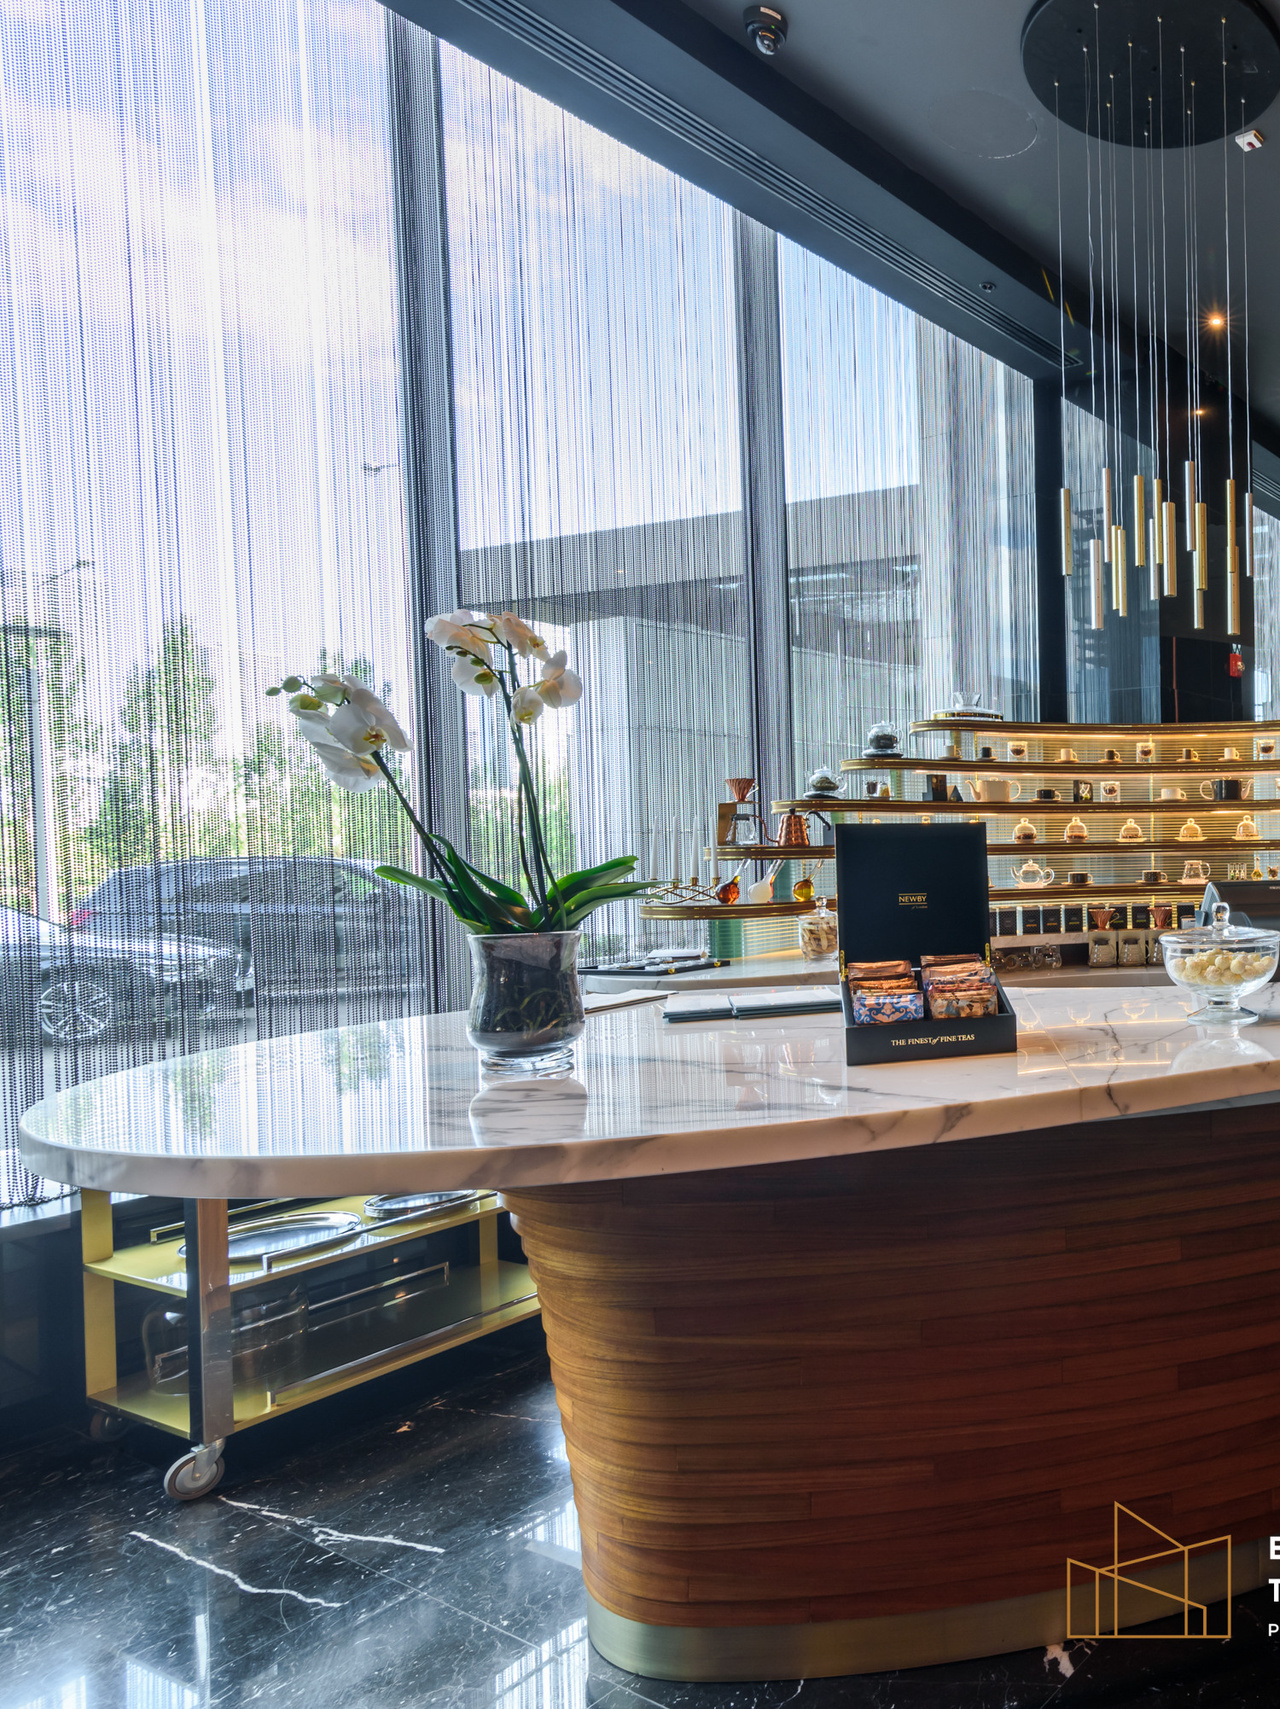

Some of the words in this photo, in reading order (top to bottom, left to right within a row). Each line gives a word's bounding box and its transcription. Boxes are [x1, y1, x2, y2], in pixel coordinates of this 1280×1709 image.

[898, 895, 927, 903] NEWBY
[908, 1037, 932, 1045] FINEST
[931, 1036, 940, 1045] of
